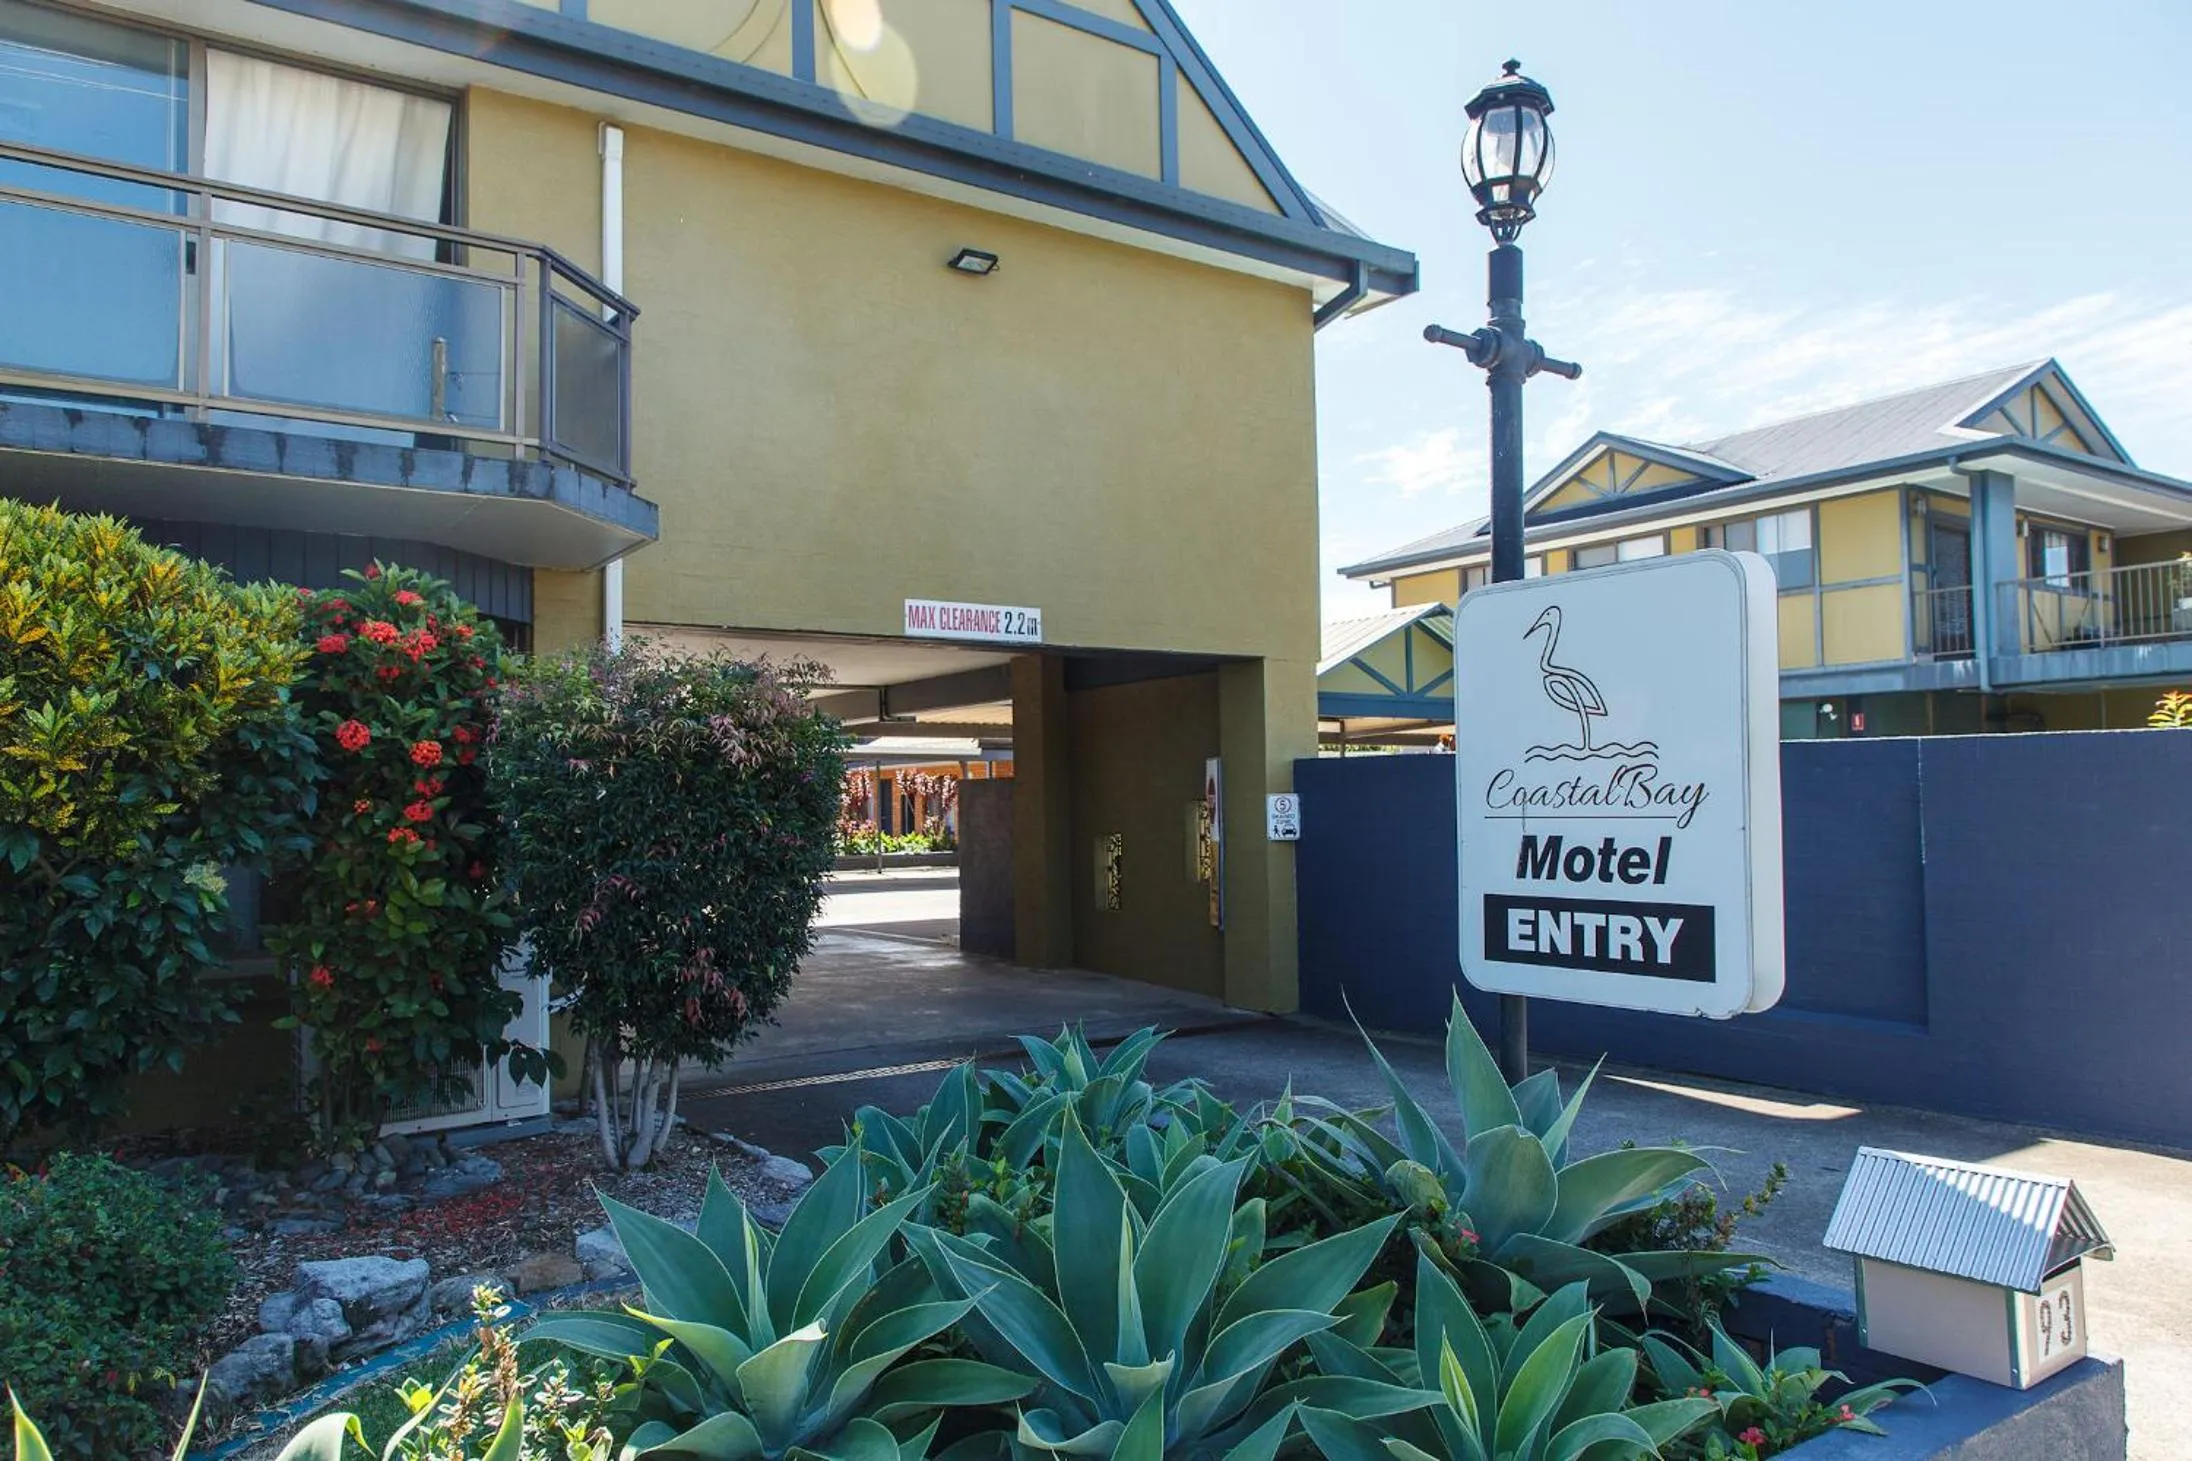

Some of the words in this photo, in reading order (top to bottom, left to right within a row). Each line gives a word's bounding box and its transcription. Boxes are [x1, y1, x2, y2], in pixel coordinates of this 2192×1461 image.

[908, 604, 936, 630] MAX
[939, 606, 1001, 634] CLEARANCE
[1279, 800, 1286, 811] 5
[1485, 764, 1623, 810] Coastal
[1618, 763, 1709, 829] Bay
[1516, 834, 1673, 885] Motel
[1507, 907, 1685, 965] ENTRY
[2039, 1289, 2072, 1356] 93
